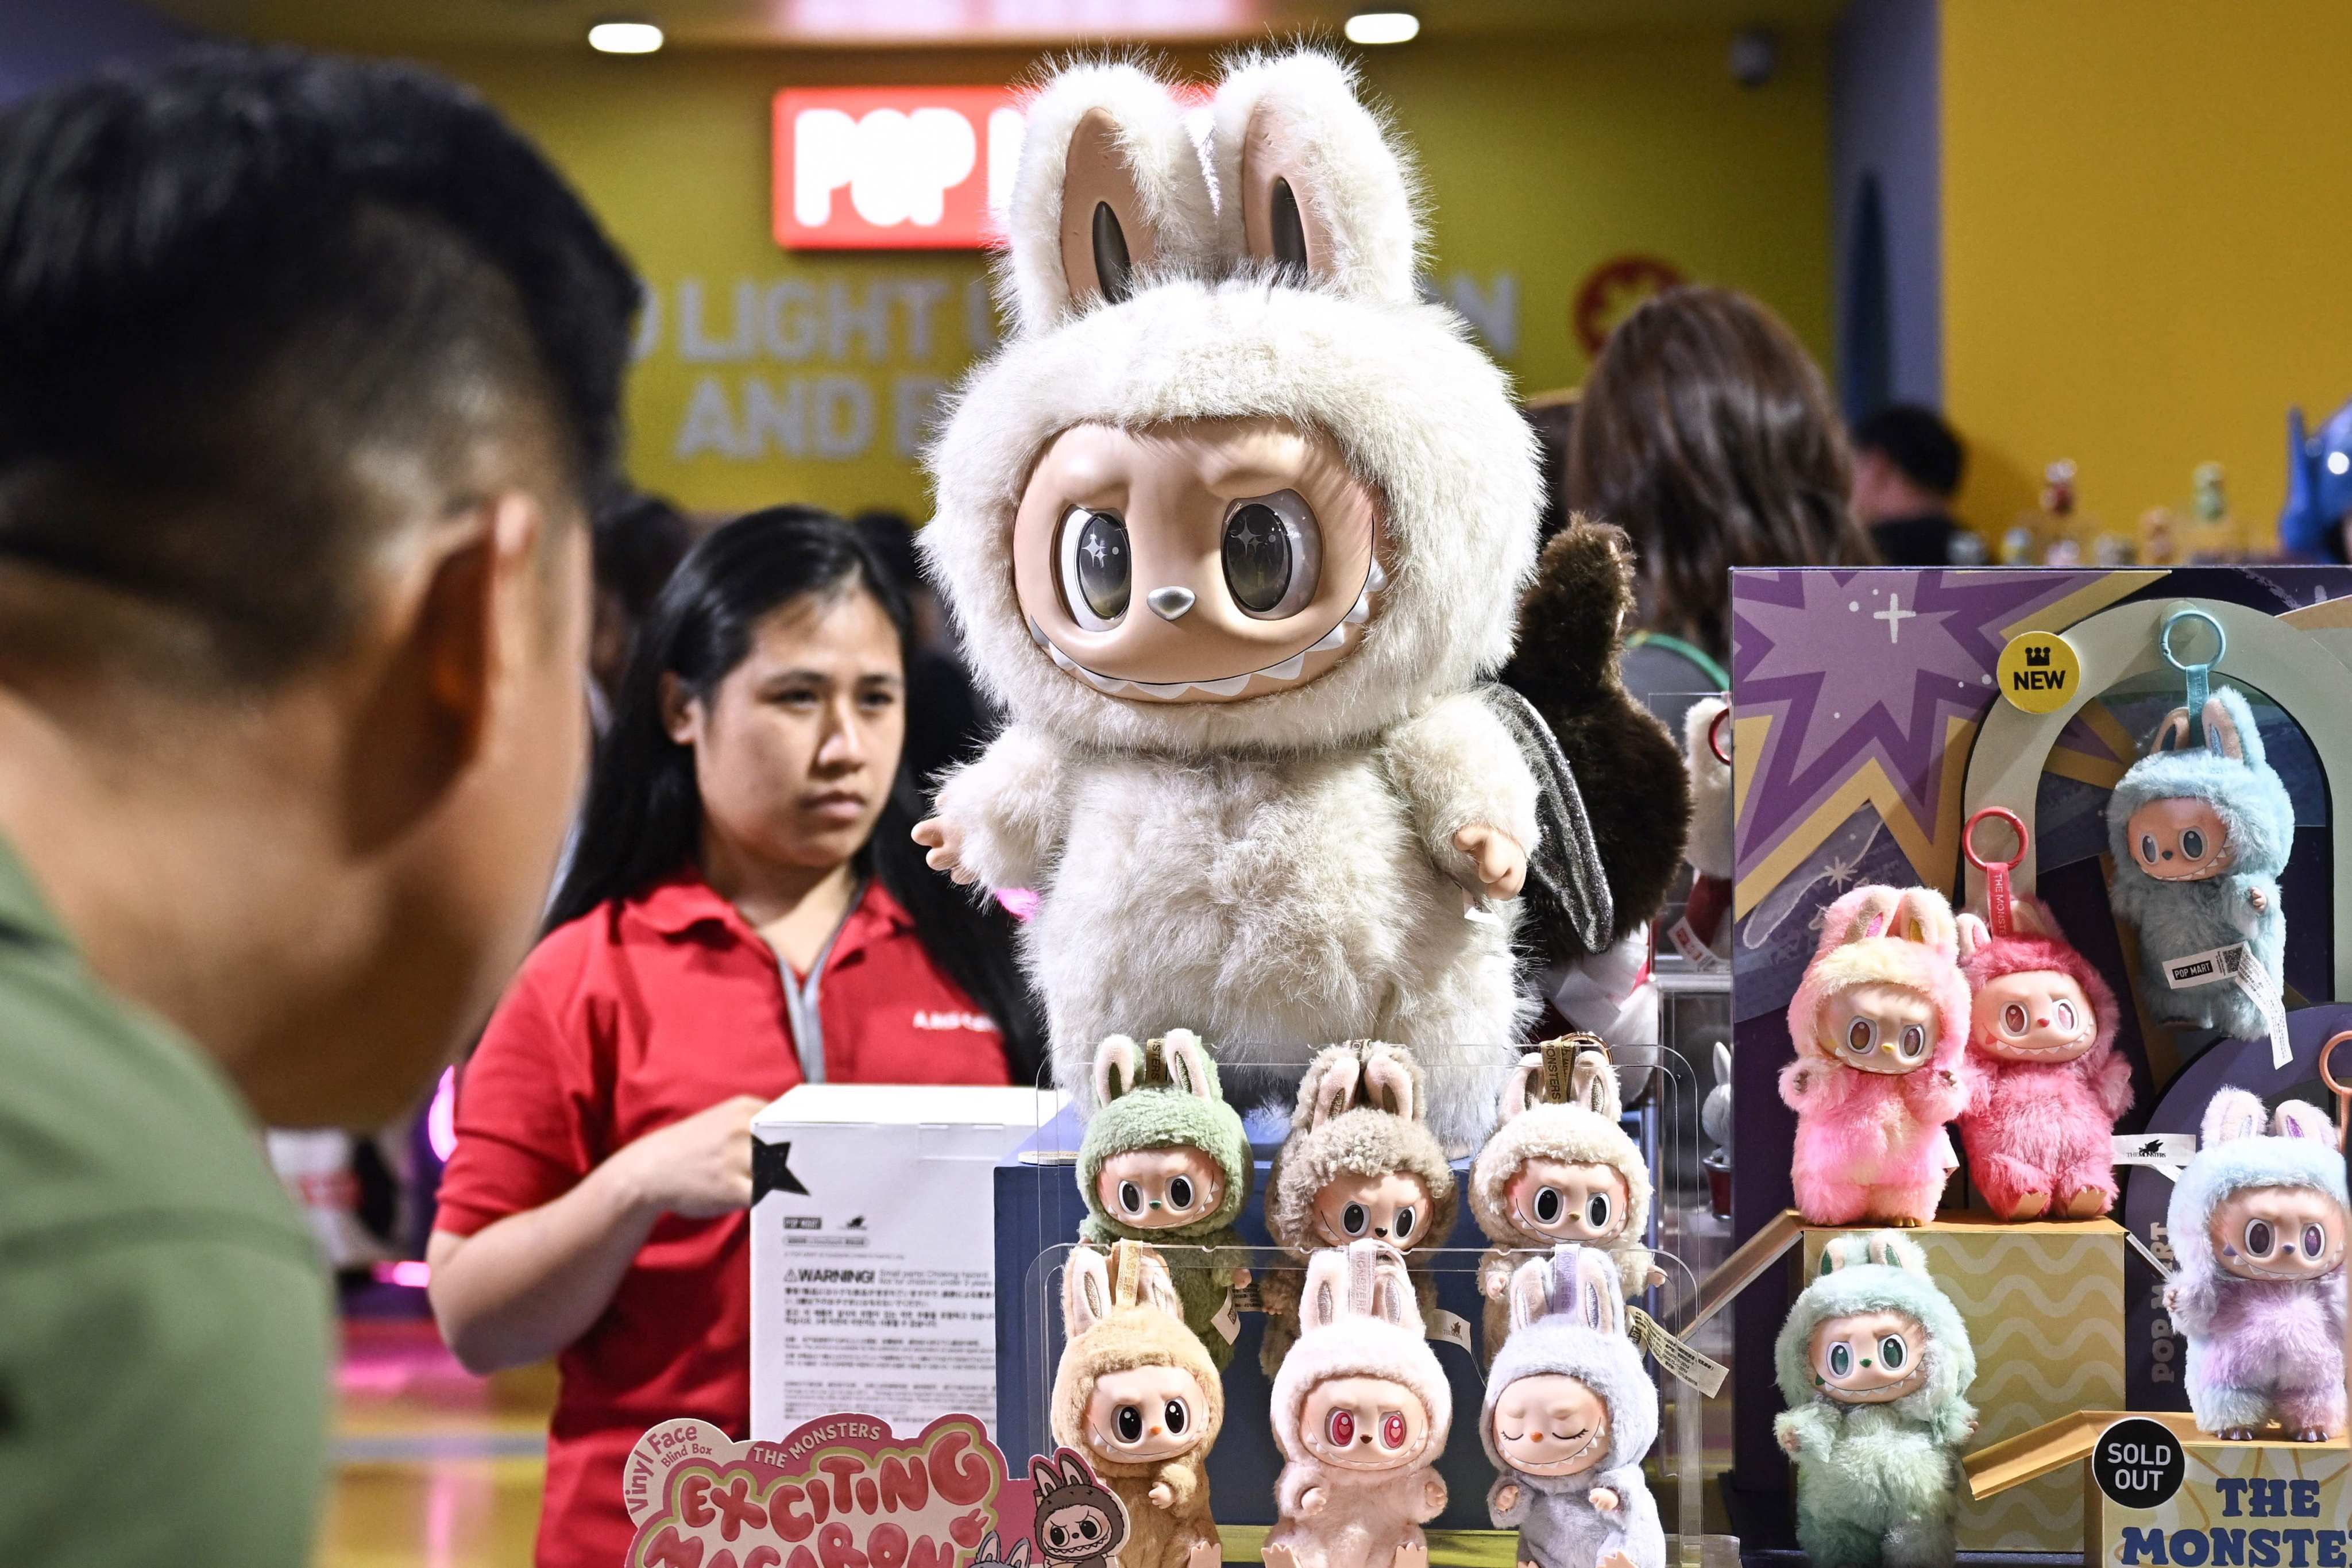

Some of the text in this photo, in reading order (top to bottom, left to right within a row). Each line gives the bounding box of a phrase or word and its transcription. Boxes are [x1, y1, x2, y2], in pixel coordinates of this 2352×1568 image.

[794, 107, 976, 227] POP
[677, 278, 947, 363] LIGHT
[673, 374, 878, 458] AND
[2013, 670, 2066, 690] NEW
[1993, 872, 2003, 892] THE
[2174, 968, 2189, 979] POP
[2189, 963, 2210, 975] MART
[798, 1268, 875, 1284] WARNING!
[2150, 1319, 2175, 1383] POP
[661, 1443, 713, 1468] Blind Box
[754, 1422, 880, 1469] THE MONSTERS
[2107, 1443, 2171, 1466] SOLD
[625, 1426, 697, 1515] Vinyl Face
[680, 1431, 991, 1543] EXCITING
[2115, 1468, 2164, 1492] OUT
[2215, 1478, 2320, 1518] THE
[2121, 1527, 2352, 1568] MONSTE
